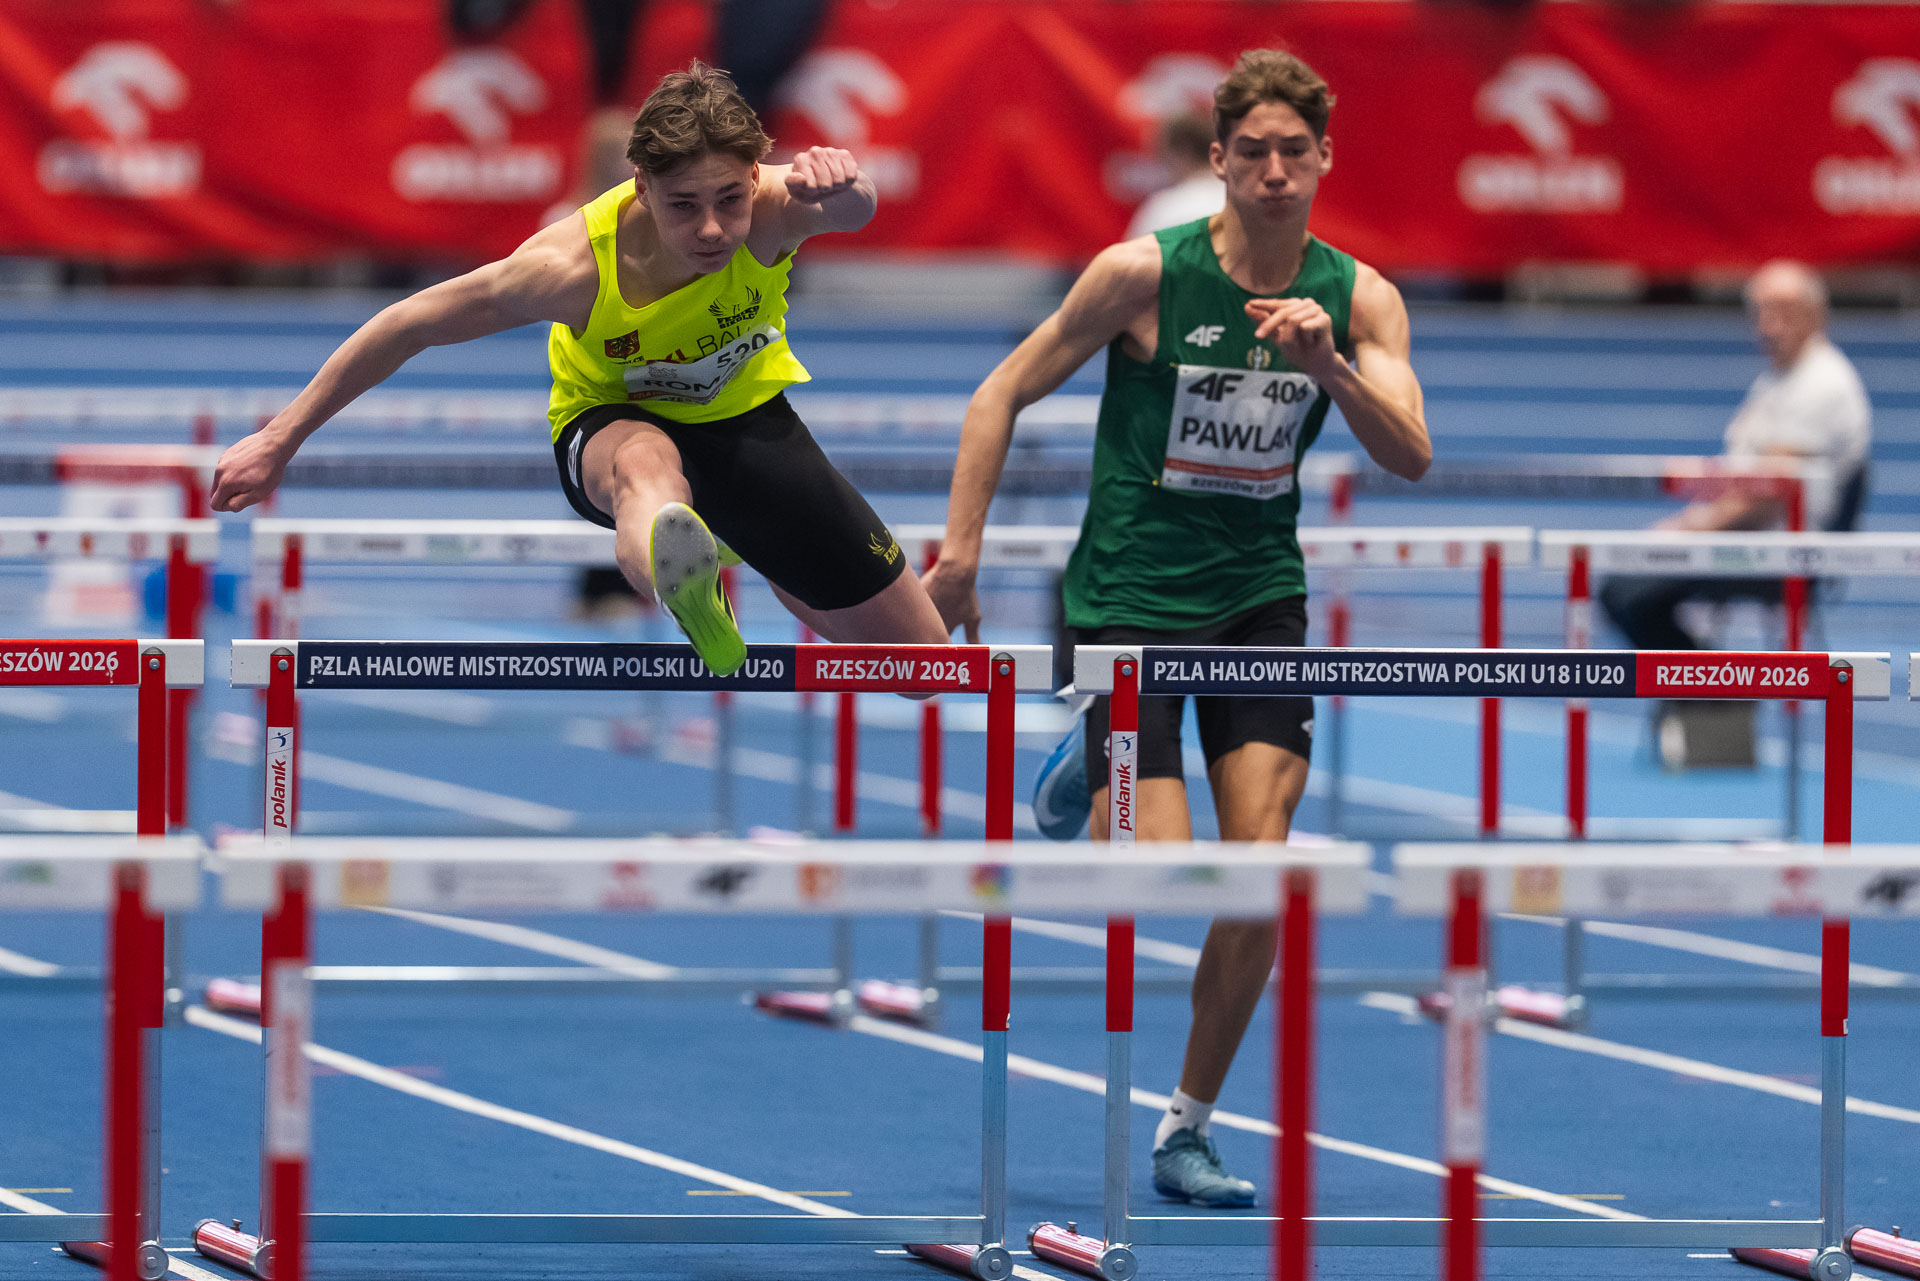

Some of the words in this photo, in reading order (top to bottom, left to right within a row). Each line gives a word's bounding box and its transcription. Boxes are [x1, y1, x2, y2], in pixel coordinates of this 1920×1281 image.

[1185, 325, 1226, 347] 4F
[1187, 373, 1244, 402] 4F
[1179, 417, 1298, 453] PAWLAK
[0, 648, 63, 672] SZÓW
[69, 652, 119, 671] 2026
[310, 656, 361, 676] PZLA
[367, 656, 454, 676] HALOWE
[460, 656, 608, 676] MISTRZOSTWA
[613, 657, 684, 677] POLSKI
[745, 658, 784, 679] U20
[816, 656, 915, 680] RZESZÓW
[920, 661, 970, 681] 2026
[1154, 661, 1205, 681] PZLA
[1210, 661, 1297, 682] HALOWE
[1302, 662, 1450, 683] MISTRZOSTWA
[1455, 663, 1526, 684] POLSKI
[1531, 664, 1571, 685] U18
[1575, 664, 1581, 684] i
[1586, 664, 1625, 685] U20
[1656, 661, 1756, 686] RZESZÓW
[1760, 666, 1810, 687] 2026
[271, 758, 288, 829] polanik
[1116, 762, 1133, 832] polanik
